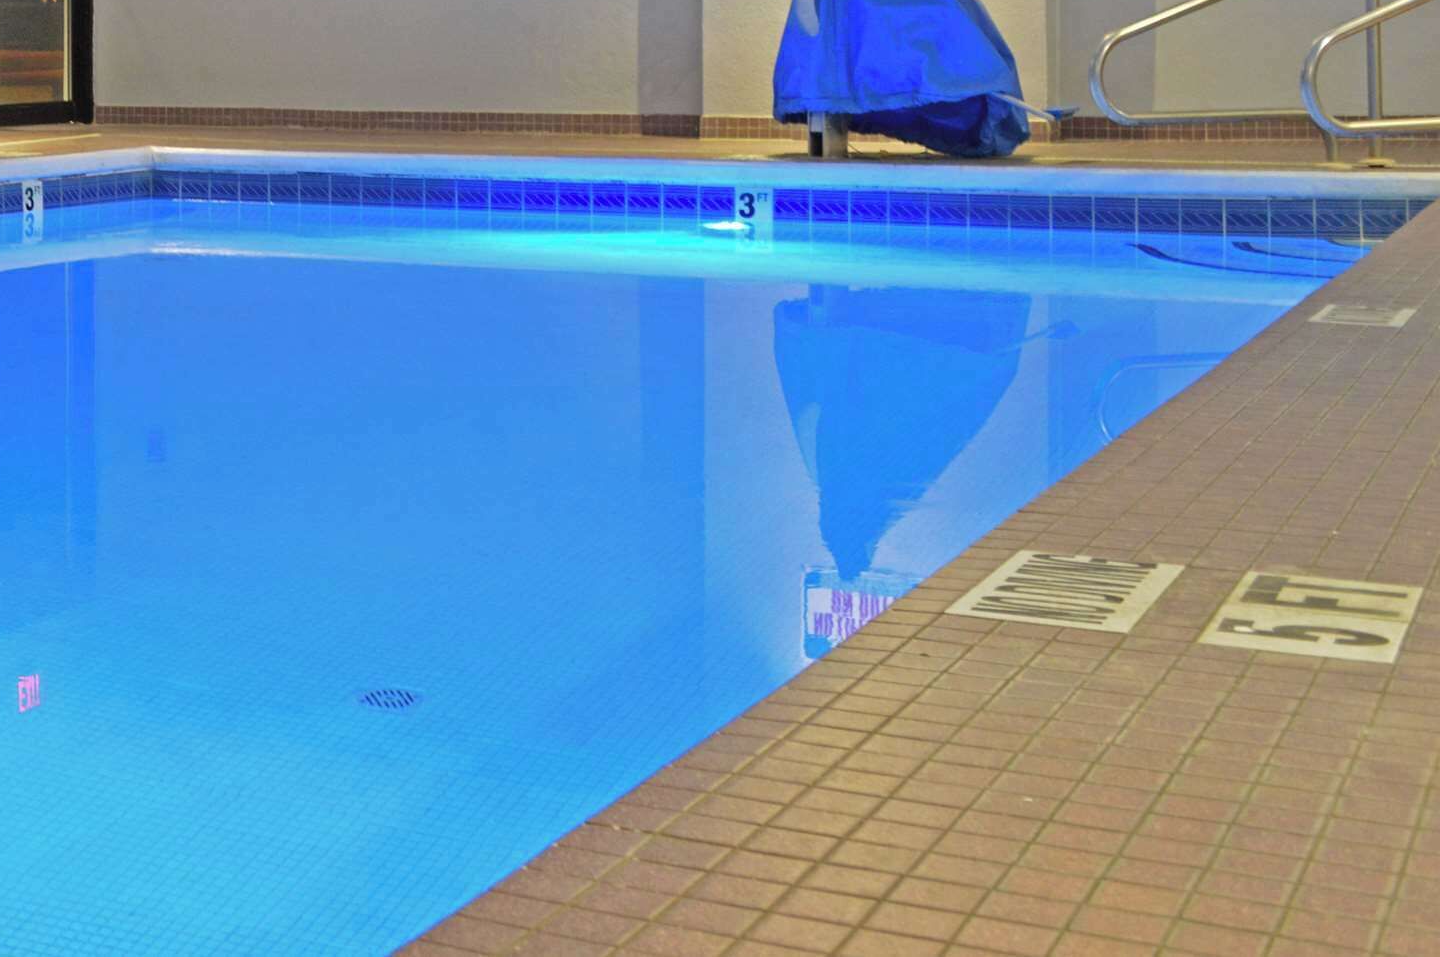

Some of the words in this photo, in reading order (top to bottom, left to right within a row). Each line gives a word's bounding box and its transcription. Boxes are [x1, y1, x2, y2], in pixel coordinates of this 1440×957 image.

[25, 187, 34, 211] 3
[739, 192, 755, 218] 3
[757, 193, 768, 202] FT
[994, 554, 1157, 604] DIVING
[971, 596, 1116, 625] NO
[1239, 575, 1408, 618] FT
[1216, 618, 1391, 646] 5
